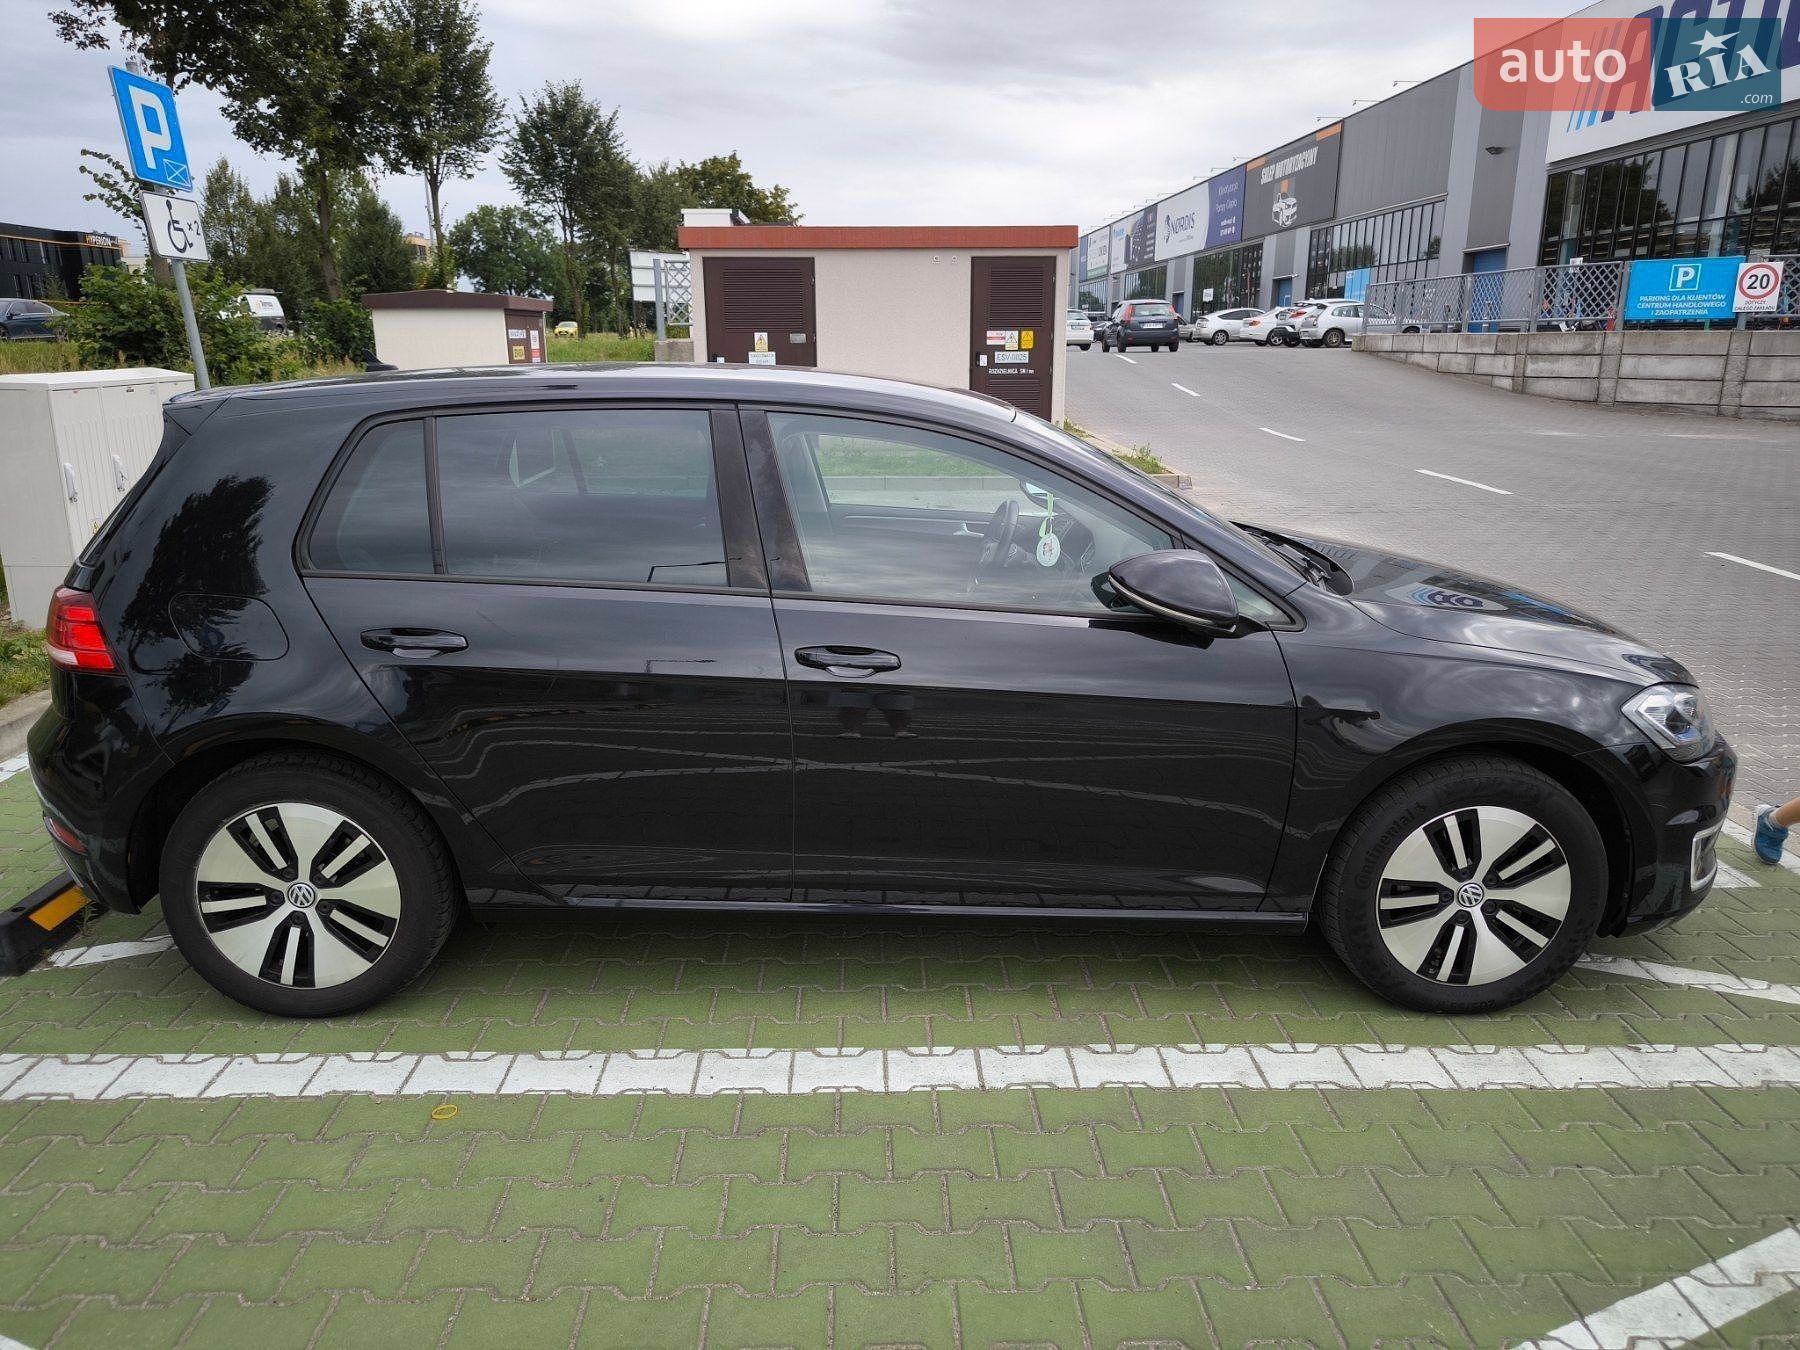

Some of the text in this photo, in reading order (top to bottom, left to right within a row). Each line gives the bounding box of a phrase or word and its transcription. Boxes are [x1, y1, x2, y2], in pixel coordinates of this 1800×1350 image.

[128, 85, 172, 170] P
[1747, 273, 1770, 290] 20
[1686, 293, 1726, 301] KLIENTÓW
[1673, 301, 1726, 309] HANDLOWEGO
